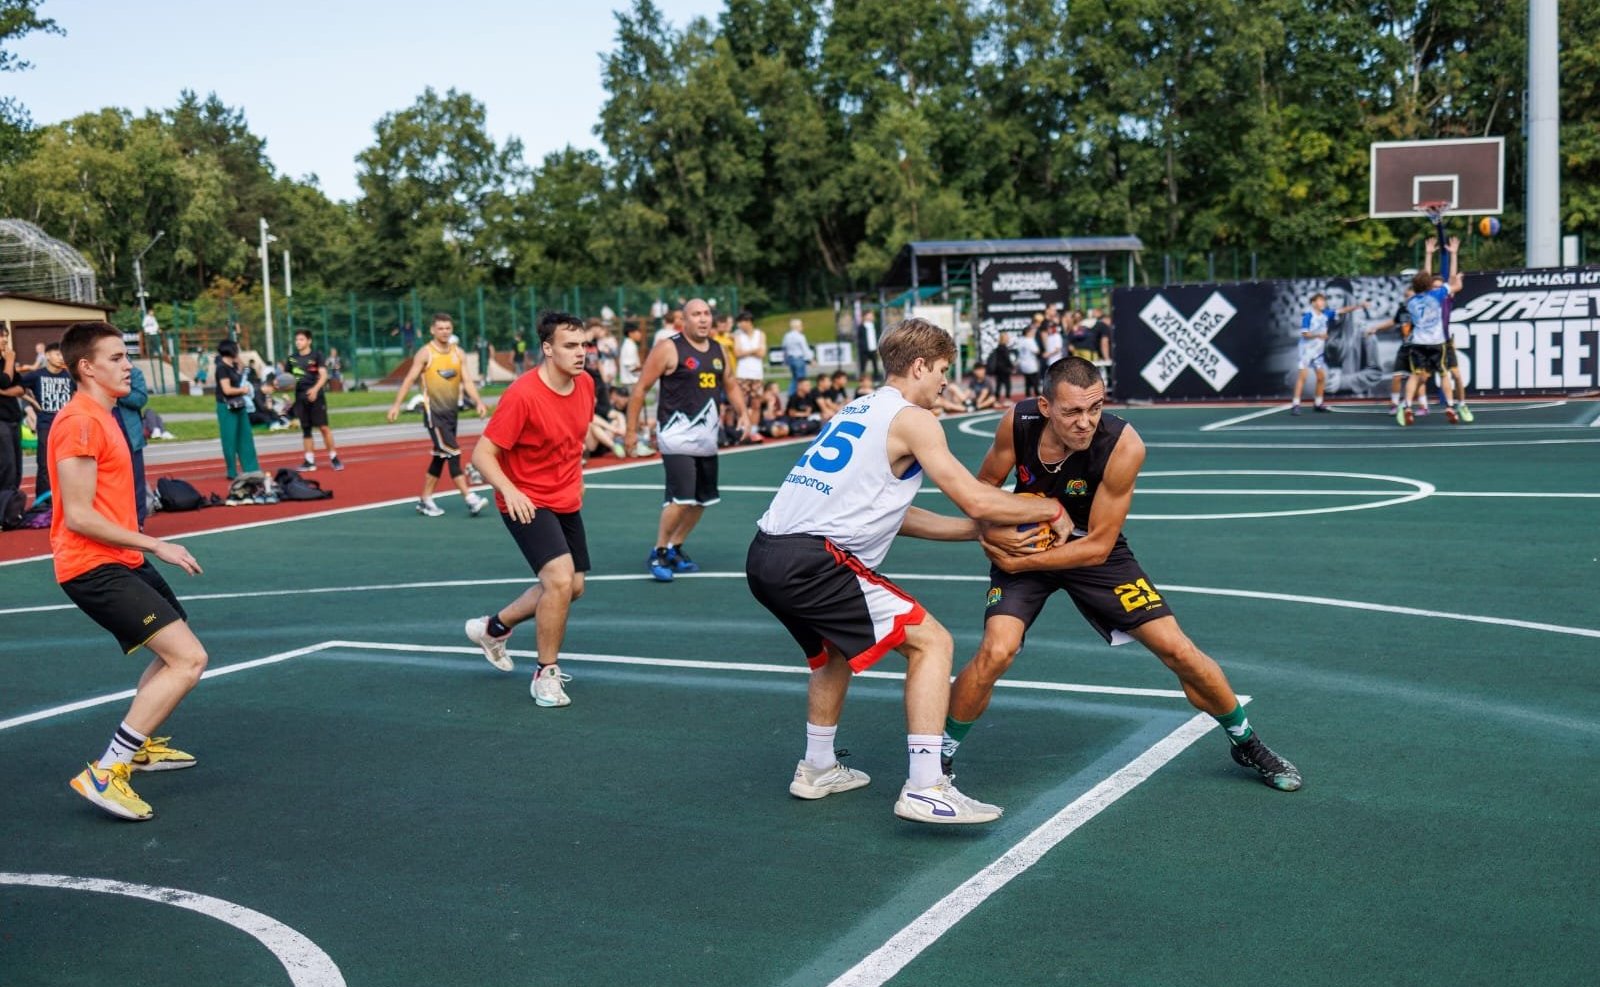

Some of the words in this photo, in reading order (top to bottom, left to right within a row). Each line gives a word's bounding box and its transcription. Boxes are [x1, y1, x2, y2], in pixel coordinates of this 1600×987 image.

[1496, 273, 1576, 287] УЛИЧНАЯ
[699, 372, 716, 389] 33
[1113, 577, 1162, 613] 21
